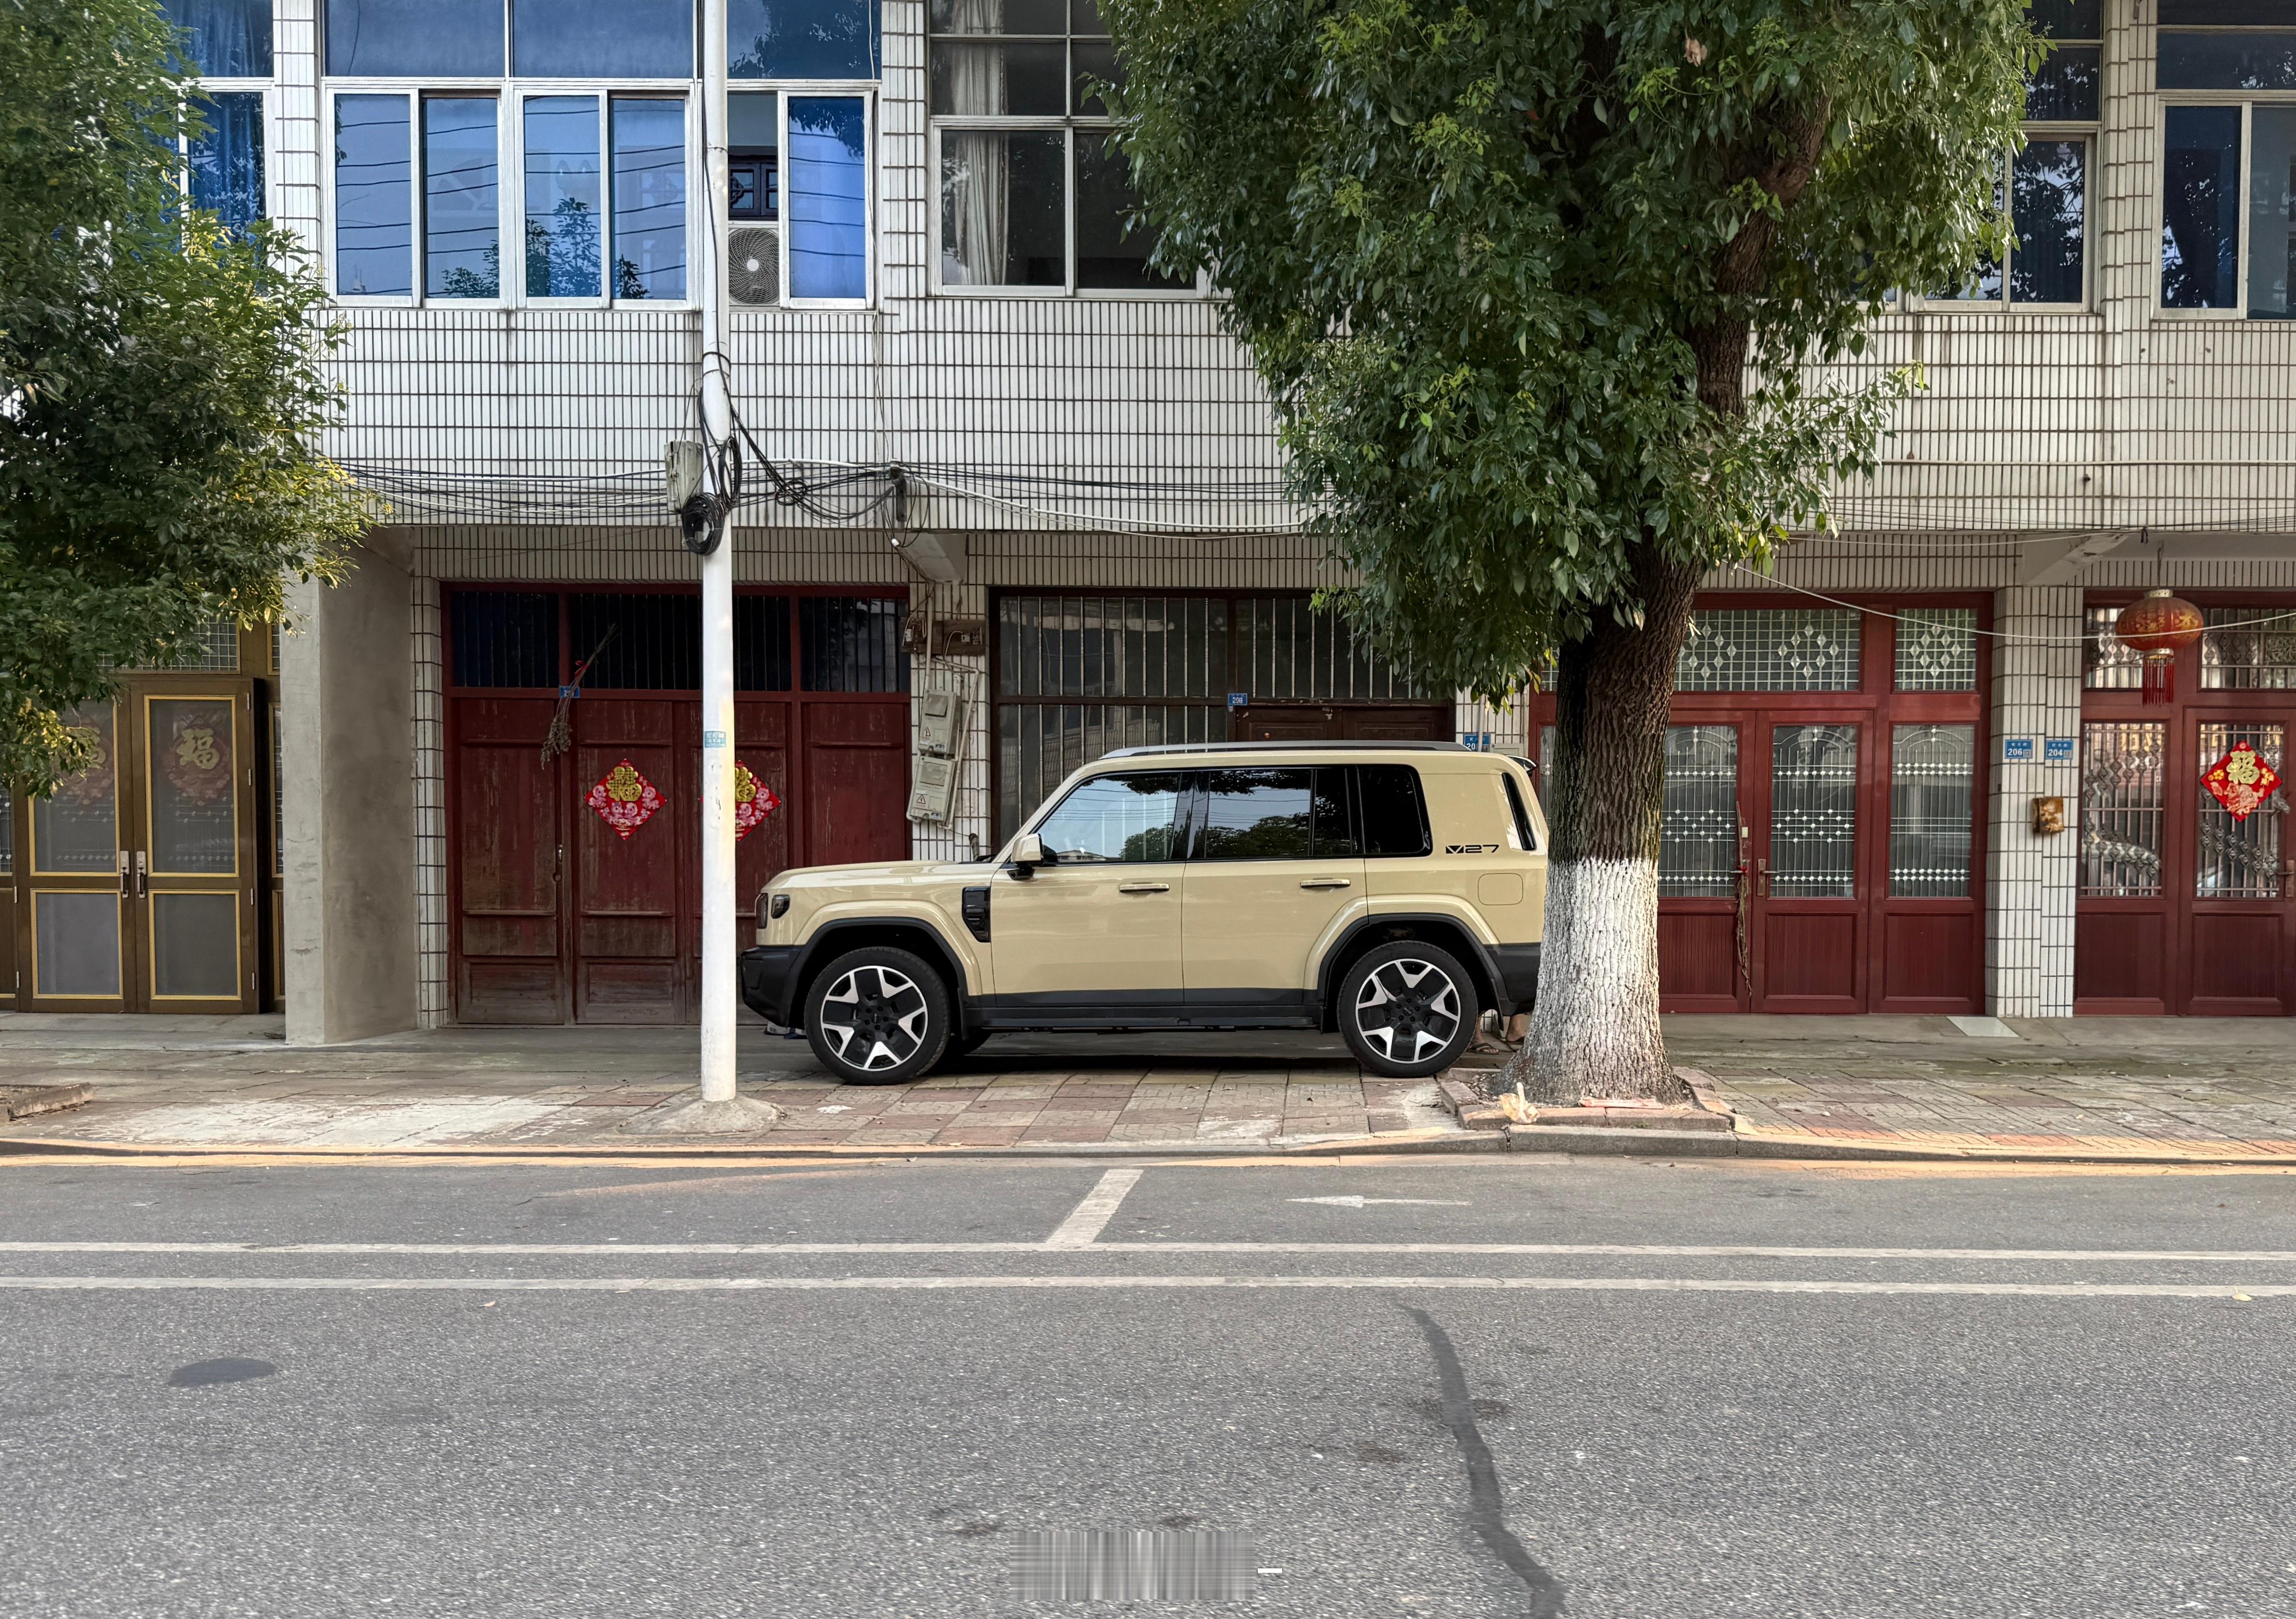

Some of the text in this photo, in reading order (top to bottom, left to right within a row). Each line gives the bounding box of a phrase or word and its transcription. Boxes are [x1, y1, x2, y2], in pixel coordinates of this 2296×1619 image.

[176, 728, 220, 770] 福
[606, 766, 642, 802] 福
[2226, 750, 2260, 784] 福
[1446, 844, 1499, 854] V27
